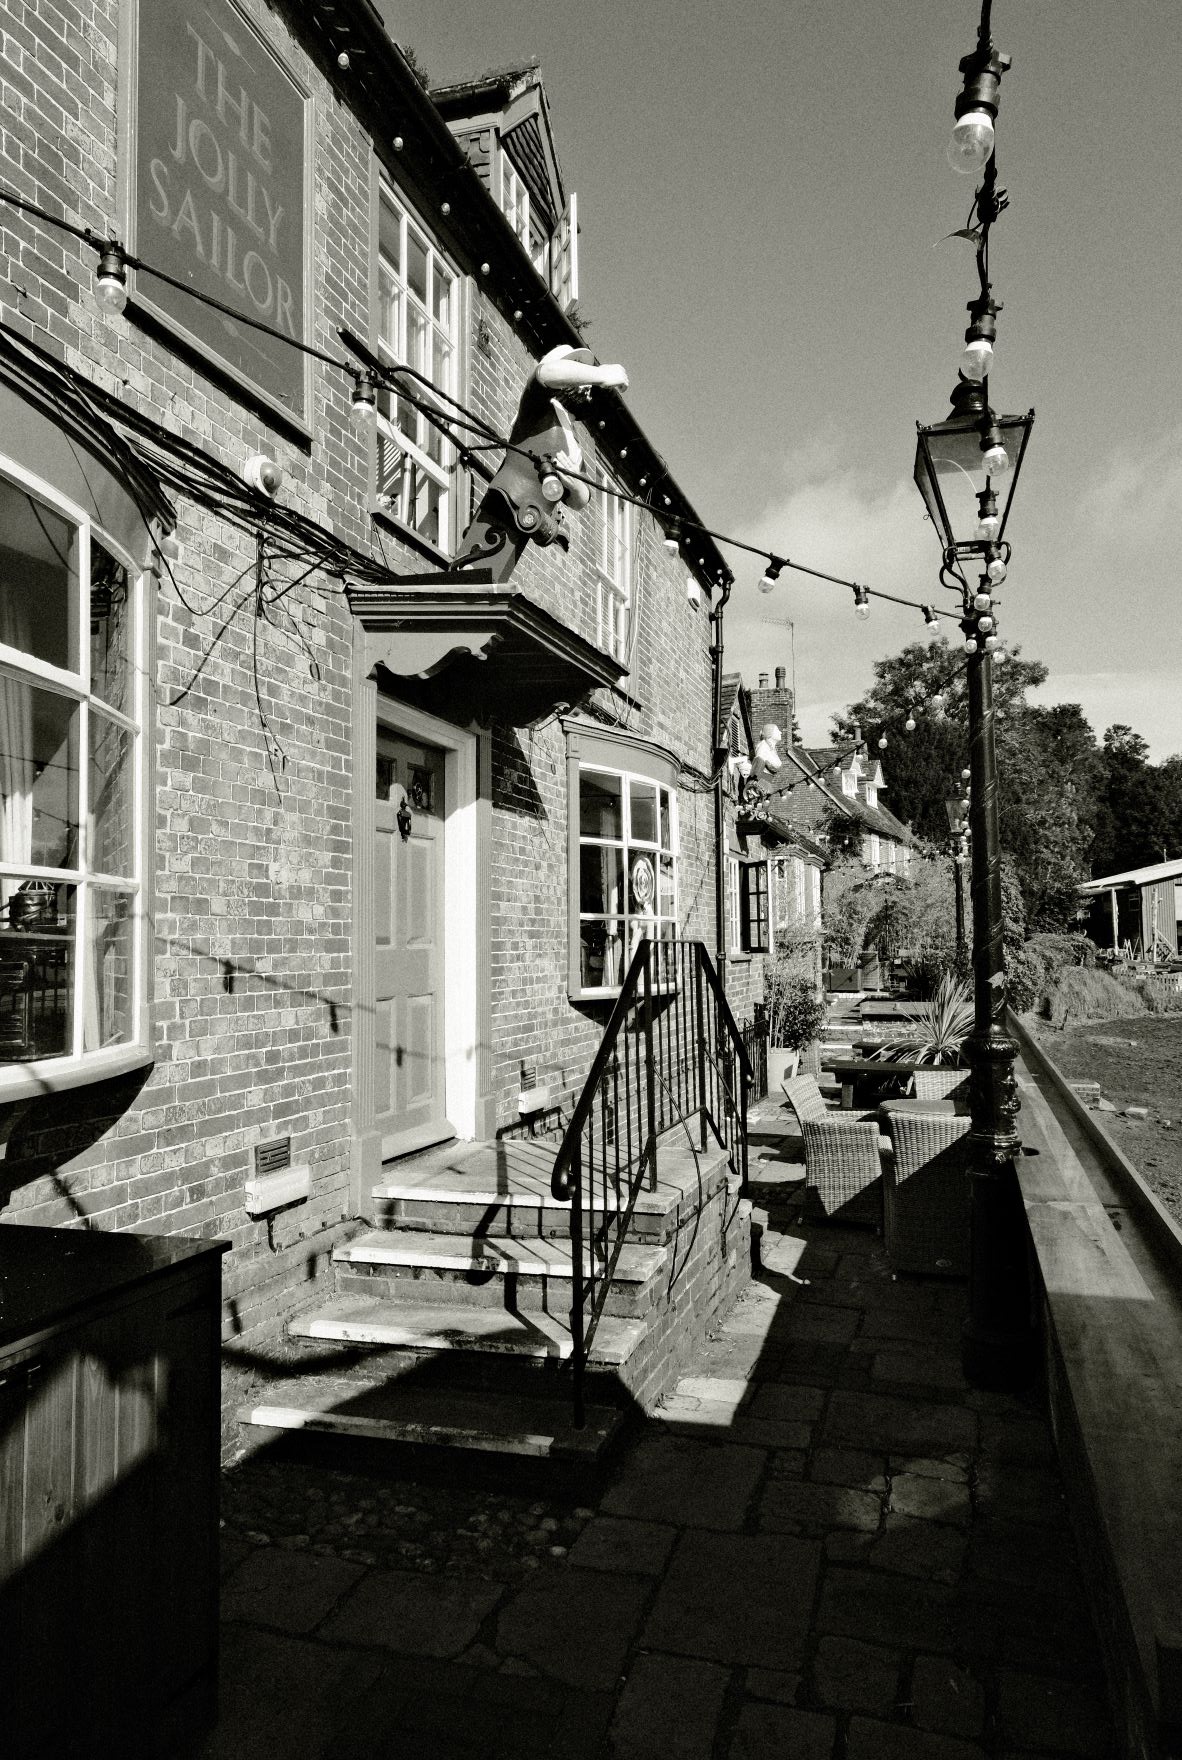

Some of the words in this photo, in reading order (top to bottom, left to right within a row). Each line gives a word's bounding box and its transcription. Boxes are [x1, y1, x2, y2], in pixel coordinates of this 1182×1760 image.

[168, 93, 284, 254] JOLLY
[186, 22, 272, 174] THE
[150, 158, 297, 341] SAILOR
